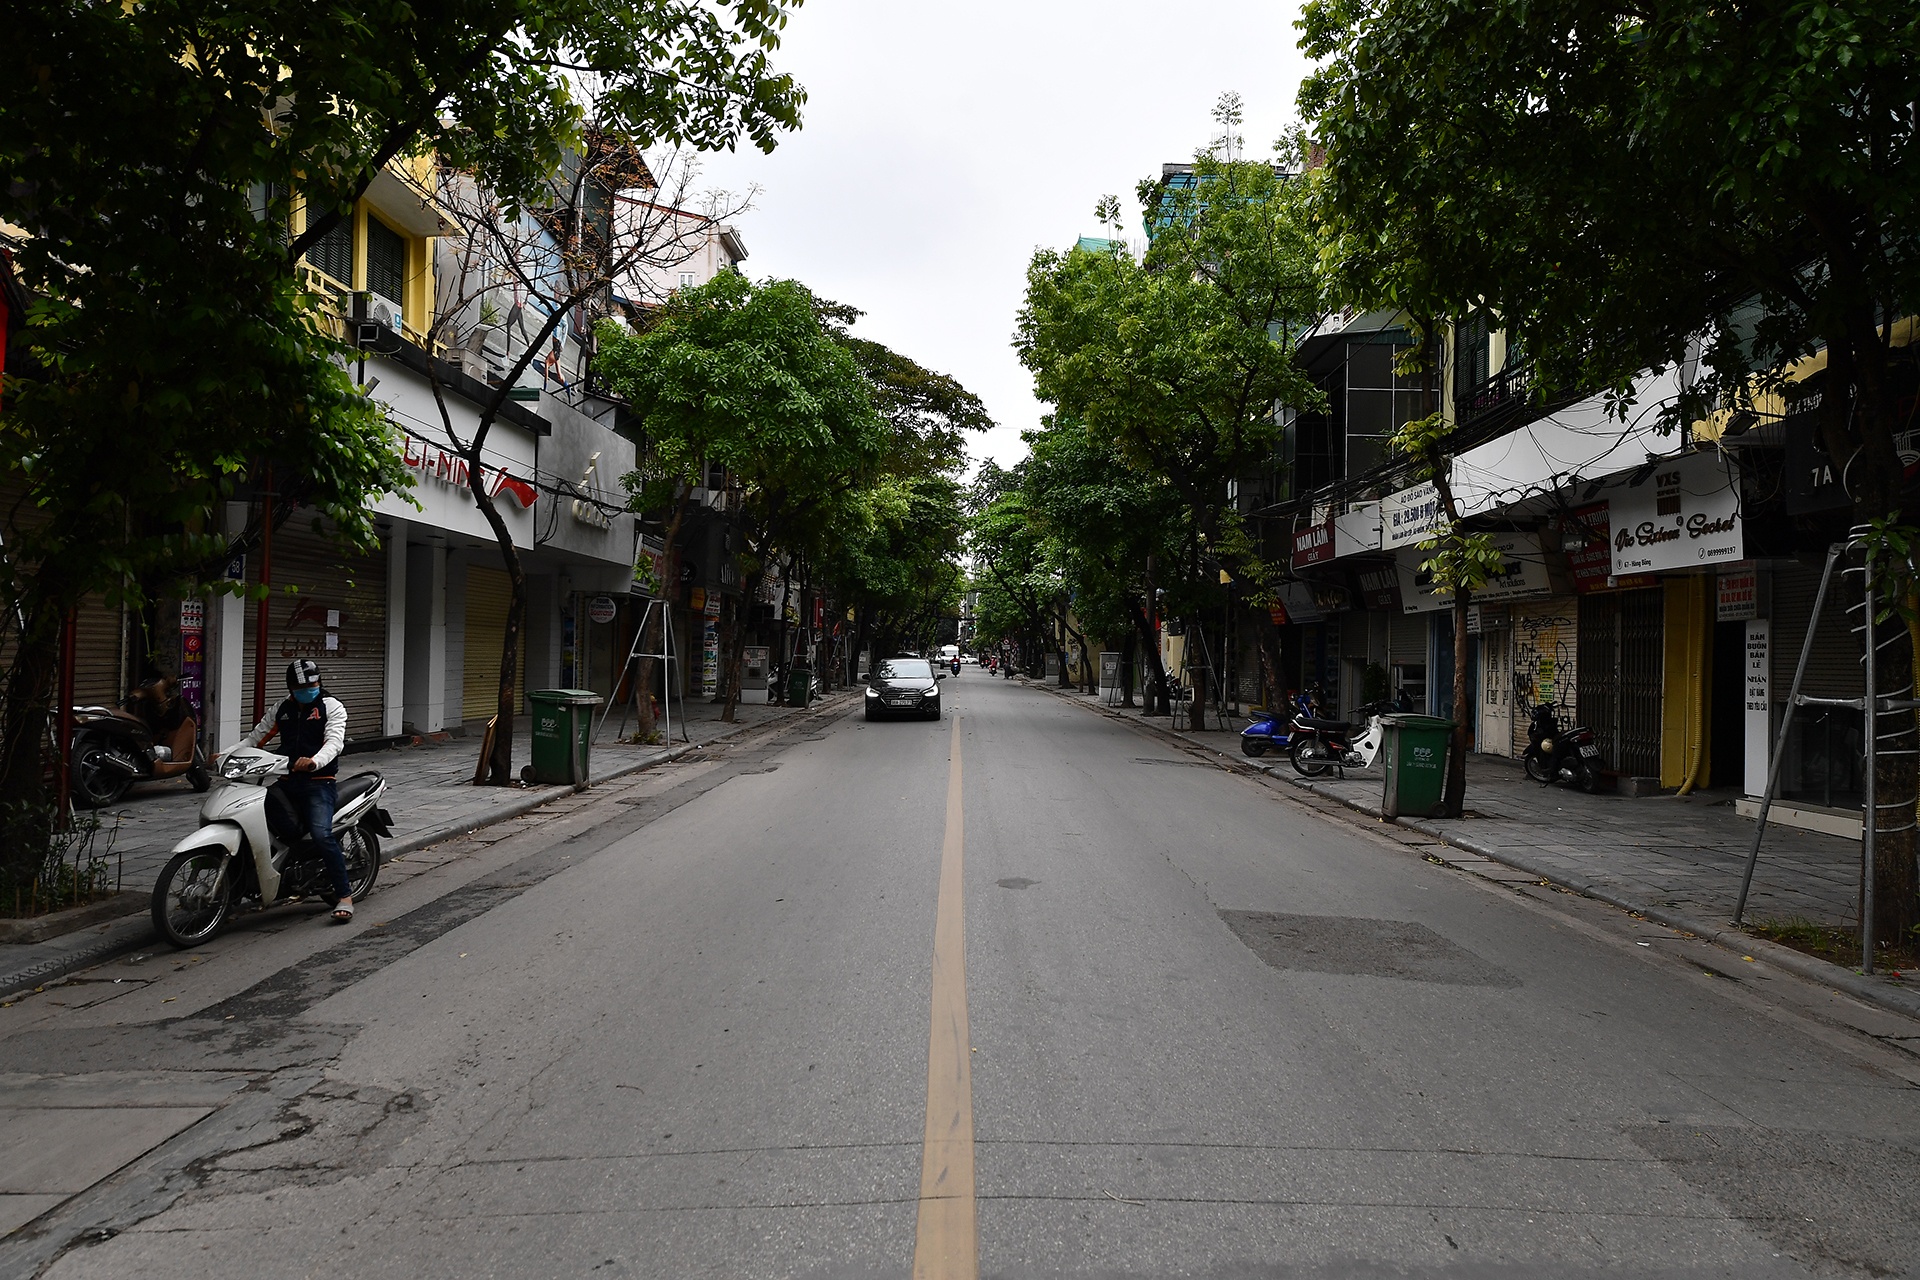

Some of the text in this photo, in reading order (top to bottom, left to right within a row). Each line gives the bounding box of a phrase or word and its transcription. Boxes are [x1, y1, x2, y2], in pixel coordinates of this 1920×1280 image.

[1656, 471, 1681, 488] VXS
[1414, 490, 1423, 500] SAO
[1296, 526, 1329, 552] NAM LÂM
[1360, 571, 1381, 591] NAM
[1747, 674, 1767, 685] NHẬN
